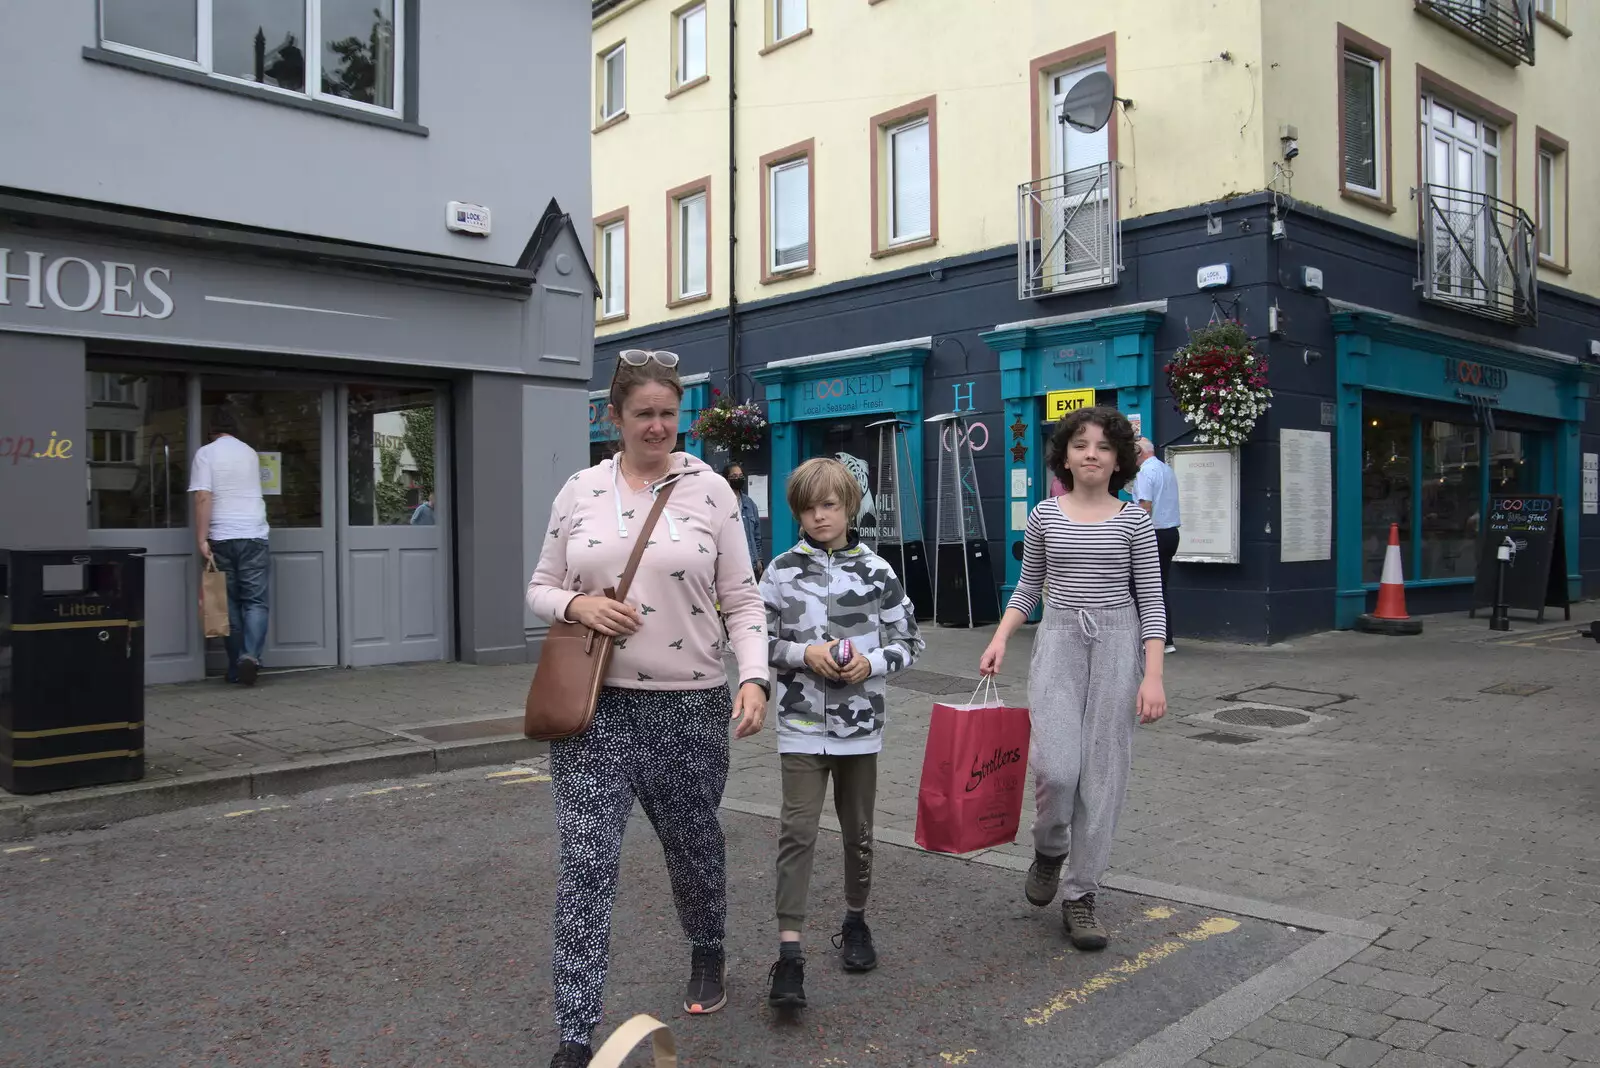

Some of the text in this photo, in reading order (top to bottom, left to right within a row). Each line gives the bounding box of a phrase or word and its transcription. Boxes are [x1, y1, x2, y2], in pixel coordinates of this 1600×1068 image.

[1445, 357, 1508, 390] HOOKED
[803, 375, 884, 400] HOOKED
[804, 398, 884, 415] Local Seasonal Fresh
[1056, 399, 1085, 411] EXIT
[1493, 499, 1551, 512] HOOKED
[59, 603, 105, 617] Litter
[966, 747, 1021, 793] Strollers
